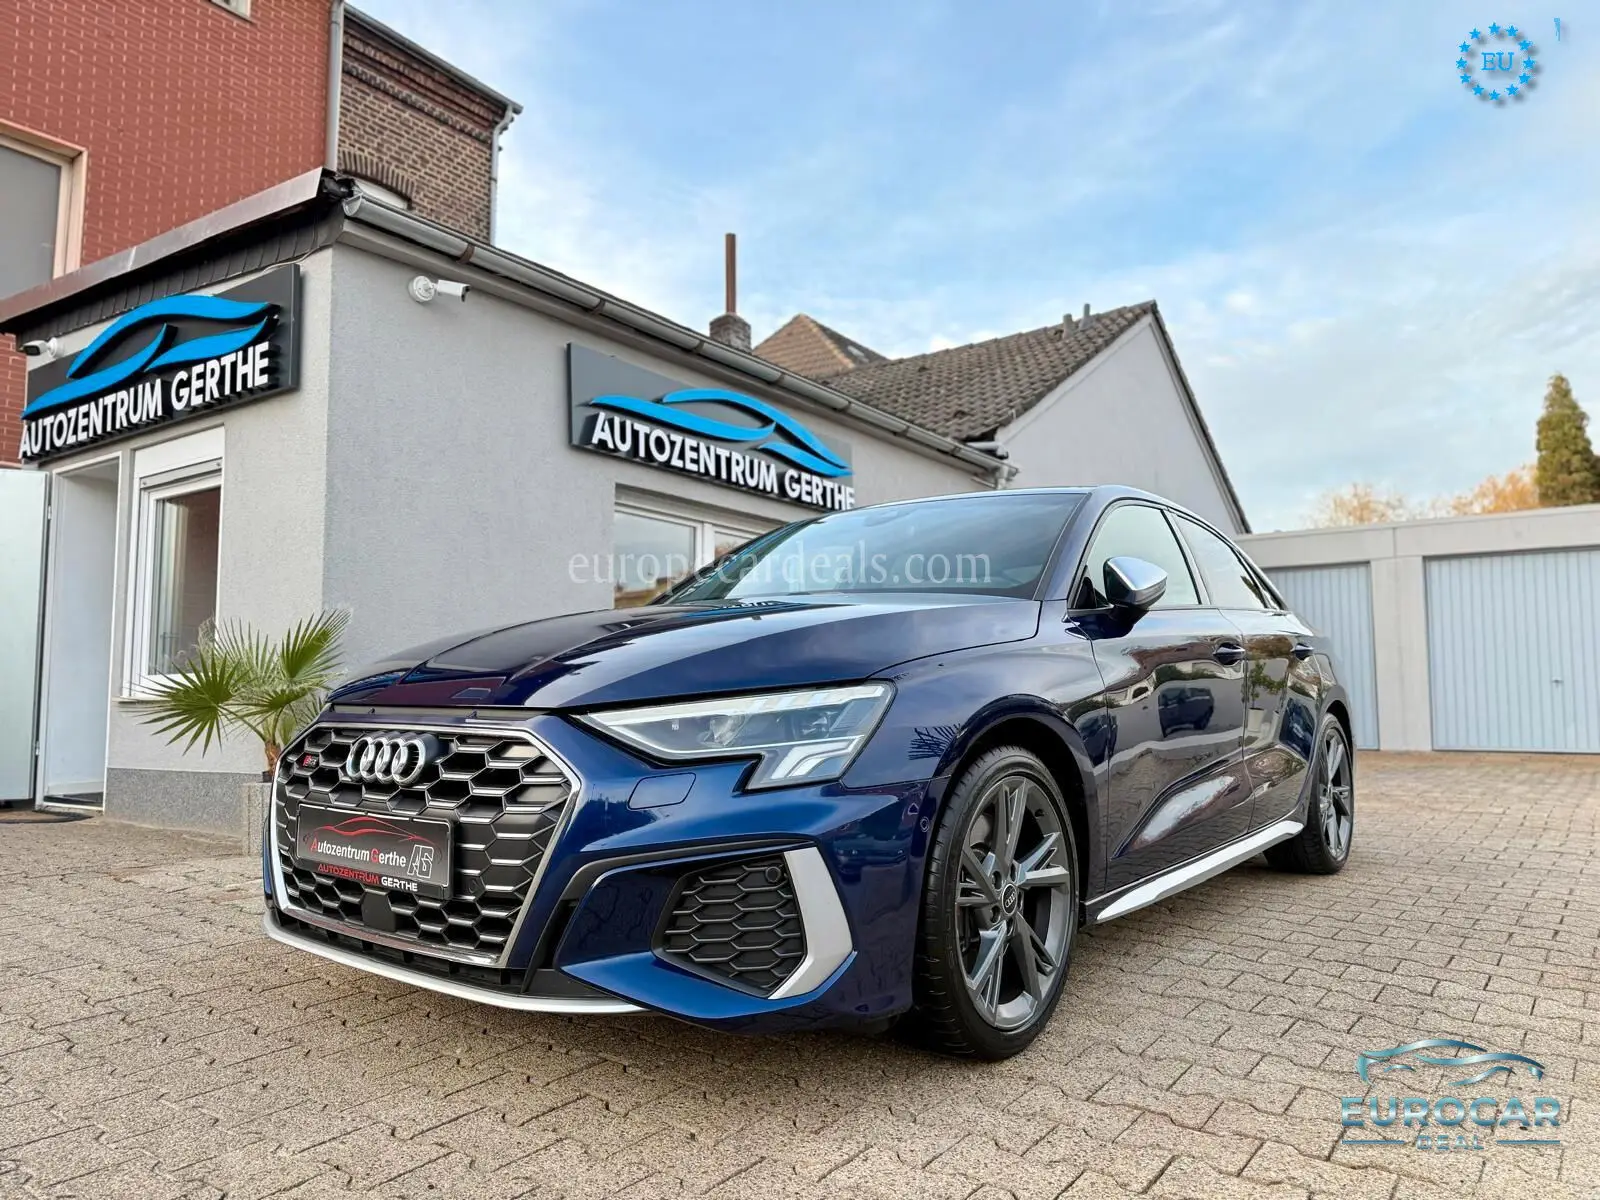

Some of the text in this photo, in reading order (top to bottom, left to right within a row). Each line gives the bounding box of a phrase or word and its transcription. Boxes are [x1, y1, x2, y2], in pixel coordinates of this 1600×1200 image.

[18, 341, 270, 460] AUTOZENTRUM GERTHE
[591, 411, 855, 511] AUTOZENTRUM GERTHE
[310, 838, 407, 868] Autozentrum Gerthe
[317, 863, 418, 892] AUTOZENTRUM GERTHE
